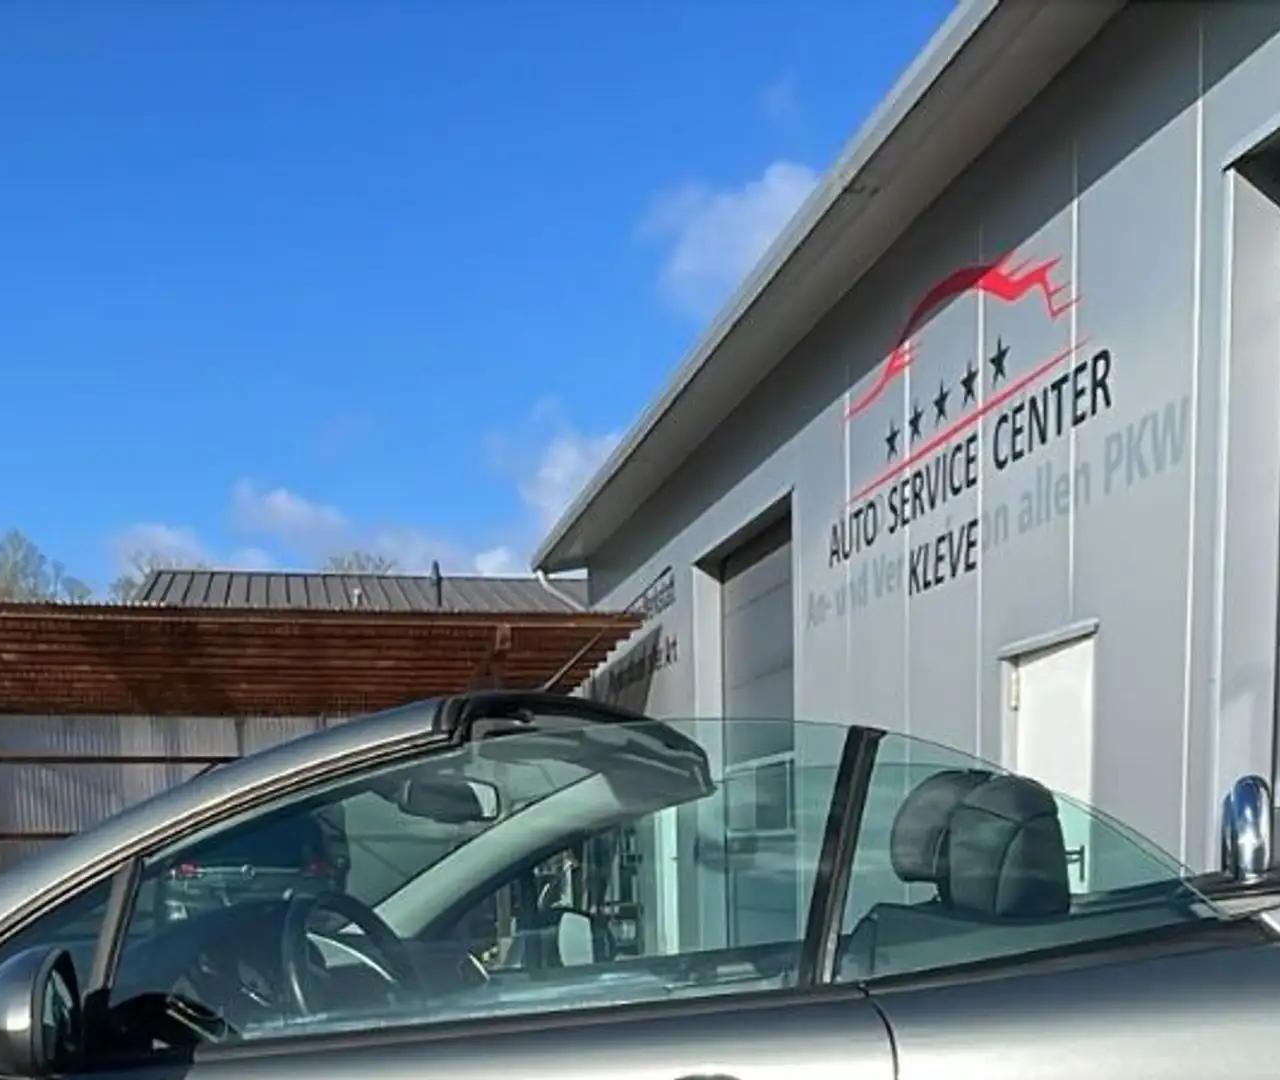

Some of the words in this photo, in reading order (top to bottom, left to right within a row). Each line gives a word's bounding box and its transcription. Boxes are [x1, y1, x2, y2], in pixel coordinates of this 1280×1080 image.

[828, 500, 878, 569] AUTO
[887, 435, 978, 535] SERVICE
[992, 347, 1112, 471] CENTER
[1017, 458, 1091, 534] allen
[1102, 395, 1191, 497] PKW
[907, 518, 979, 597] KLEVE
